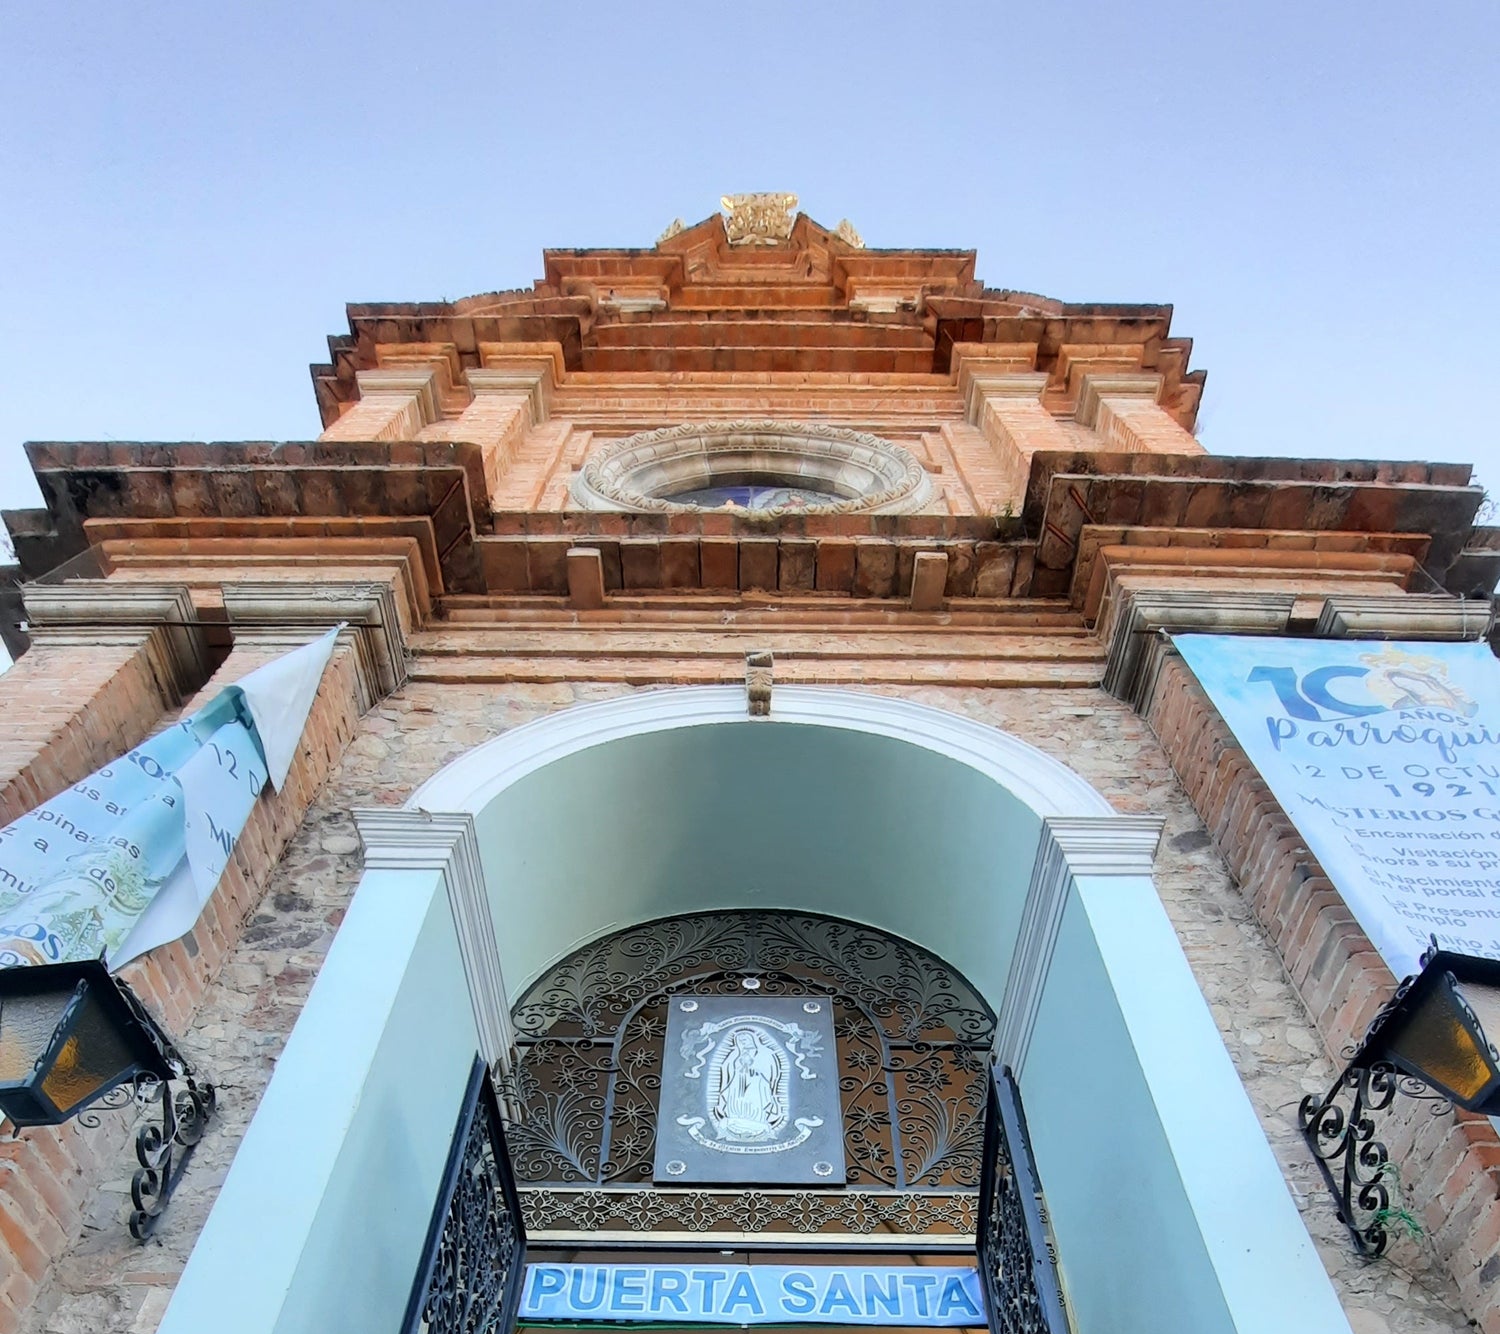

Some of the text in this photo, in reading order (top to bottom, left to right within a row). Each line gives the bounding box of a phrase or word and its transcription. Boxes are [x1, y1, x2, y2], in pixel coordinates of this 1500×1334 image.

[1399, 708, 1470, 727] AÑOS
[1266, 716, 1500, 764] Parroqui
[1341, 764, 1389, 781] DE
[1384, 780, 1497, 798] 1921
[1354, 828, 1486, 841] Encarnación
[1391, 847, 1498, 859] Visitación
[1421, 887, 1486, 898] portal
[1413, 901, 1500, 919] Present
[526, 1267, 981, 1318] PUERTA SANTA
